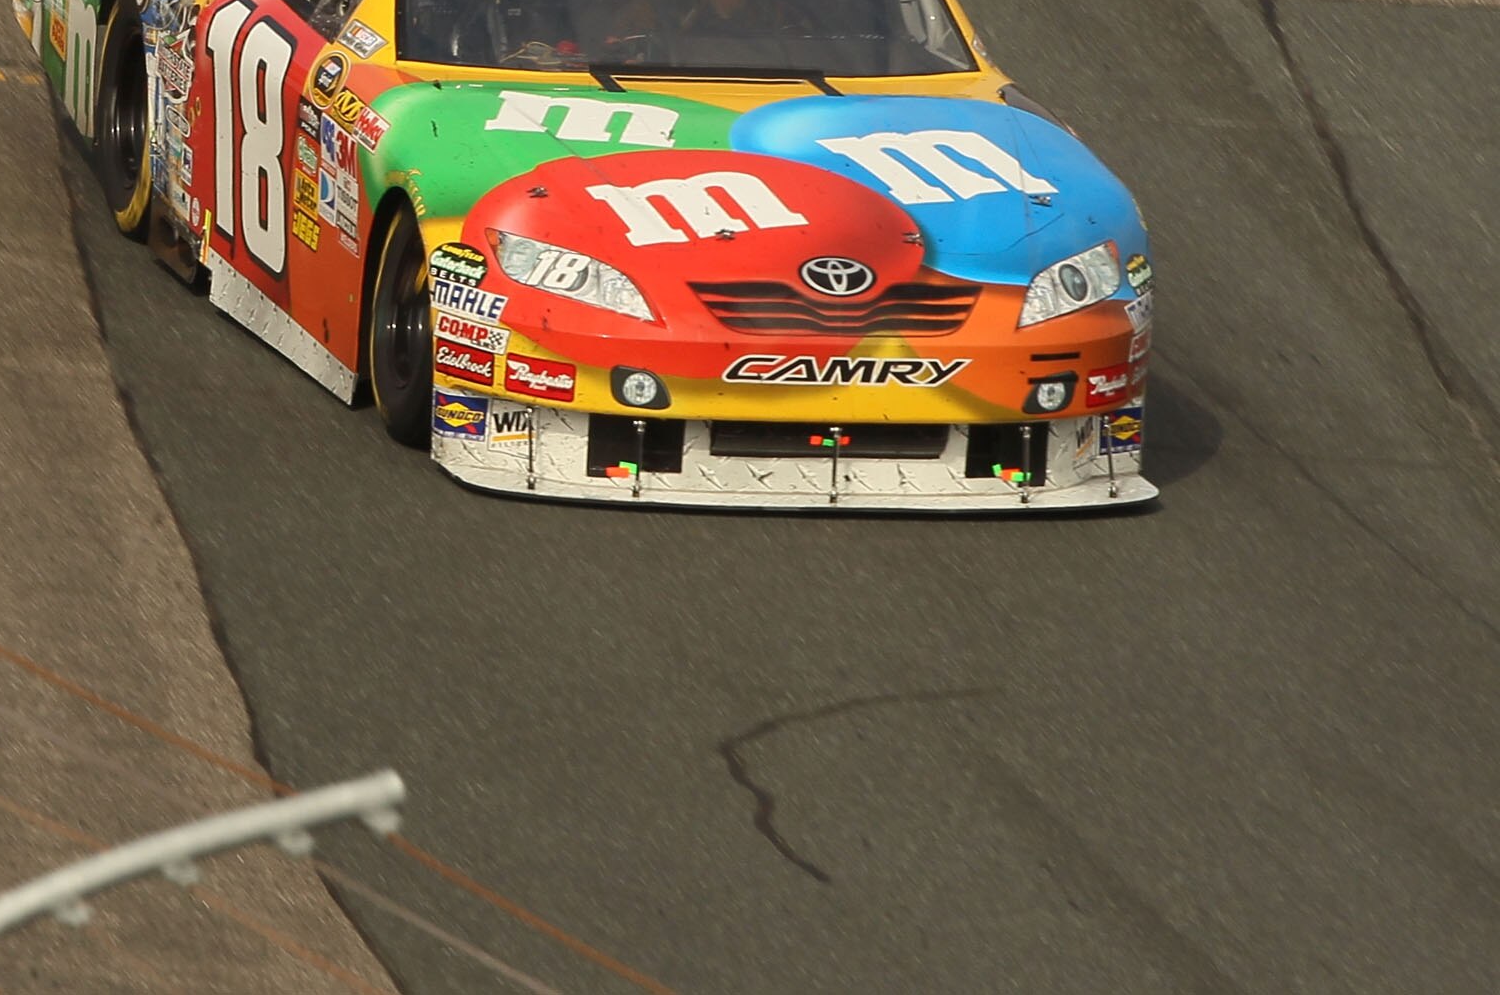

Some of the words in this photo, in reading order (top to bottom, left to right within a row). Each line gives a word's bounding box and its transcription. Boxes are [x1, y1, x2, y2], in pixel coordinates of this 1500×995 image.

[485, 89, 675, 148] m
[816, 129, 1059, 205] m
[585, 171, 809, 247] m
[430, 267, 477, 287] BELTS
[526, 250, 589, 289] 18
[434, 280, 506, 320] MAHLE
[438, 315, 489, 342] COMP
[436, 346, 492, 378] Edelbrock
[722, 354, 973, 387] CAMRY
[436, 406, 483, 422] SUNOCO
[492, 410, 536, 434] WIX
